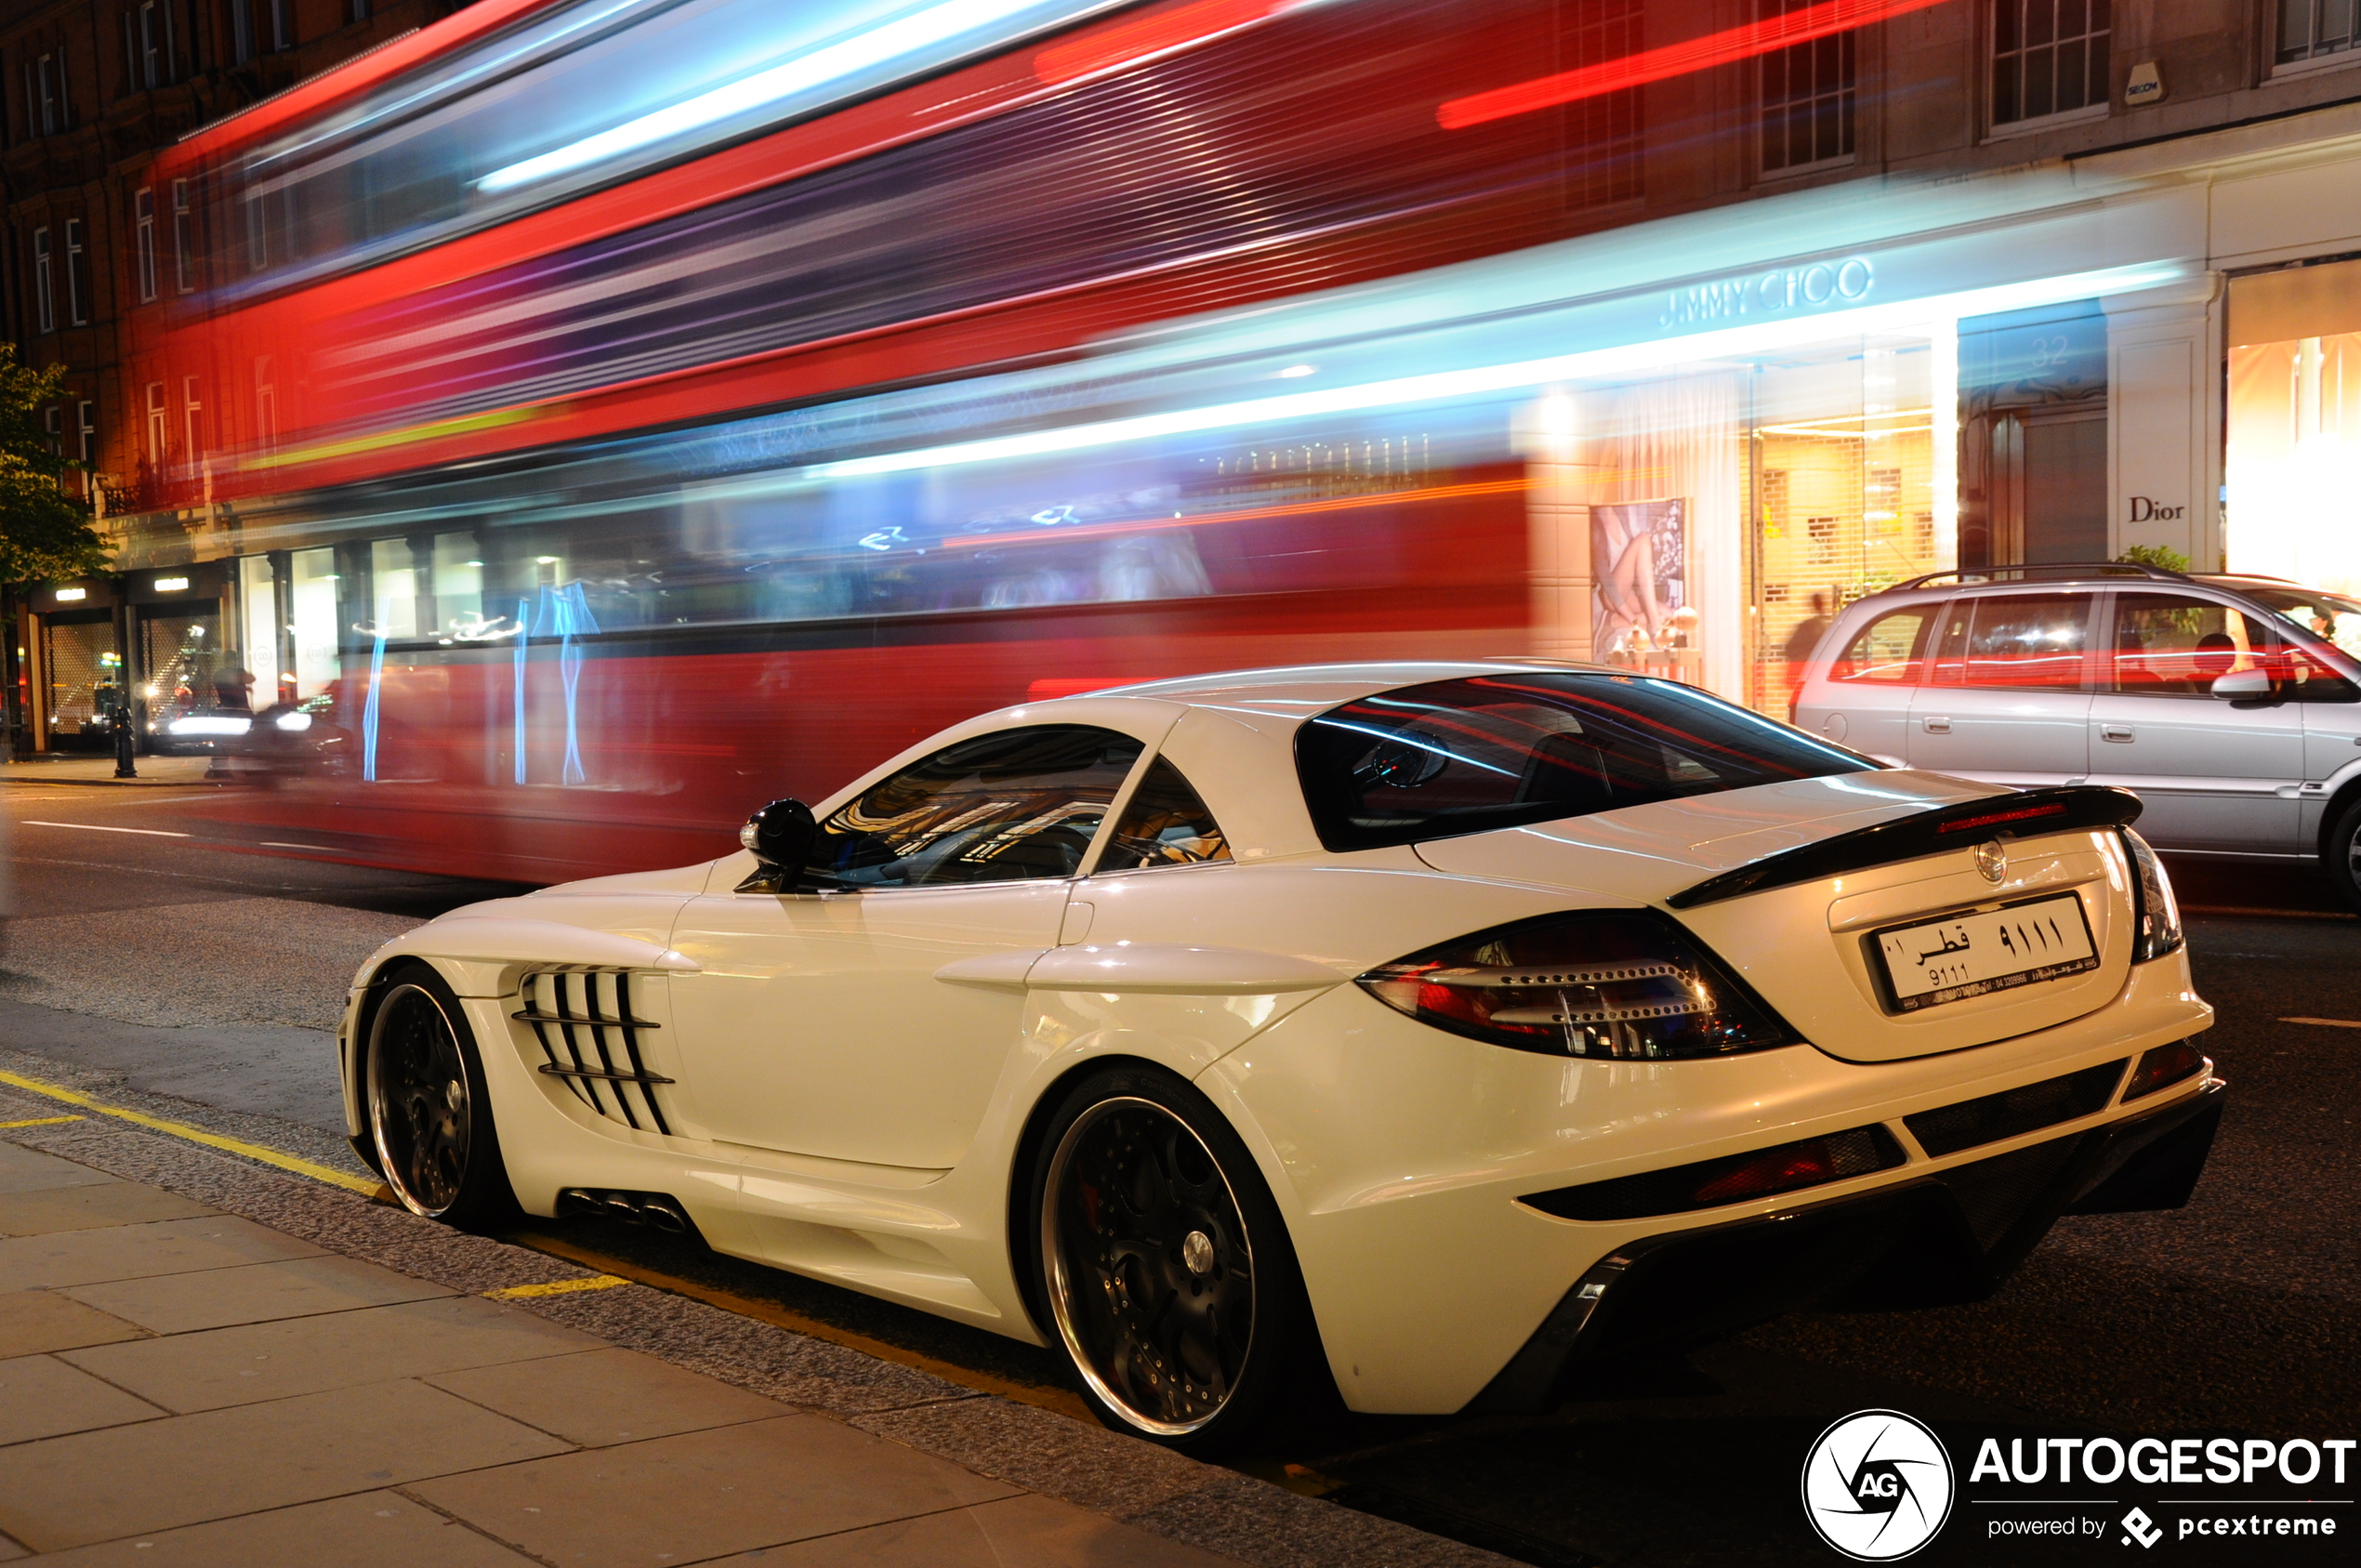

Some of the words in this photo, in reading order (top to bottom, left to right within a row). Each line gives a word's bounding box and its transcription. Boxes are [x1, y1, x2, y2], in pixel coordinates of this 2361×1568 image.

[2031, 336, 2068, 367] 32
[2128, 495, 2185, 523] Dior
[1915, 924, 1971, 967] قطر
[1929, 962, 1969, 986] 9111
